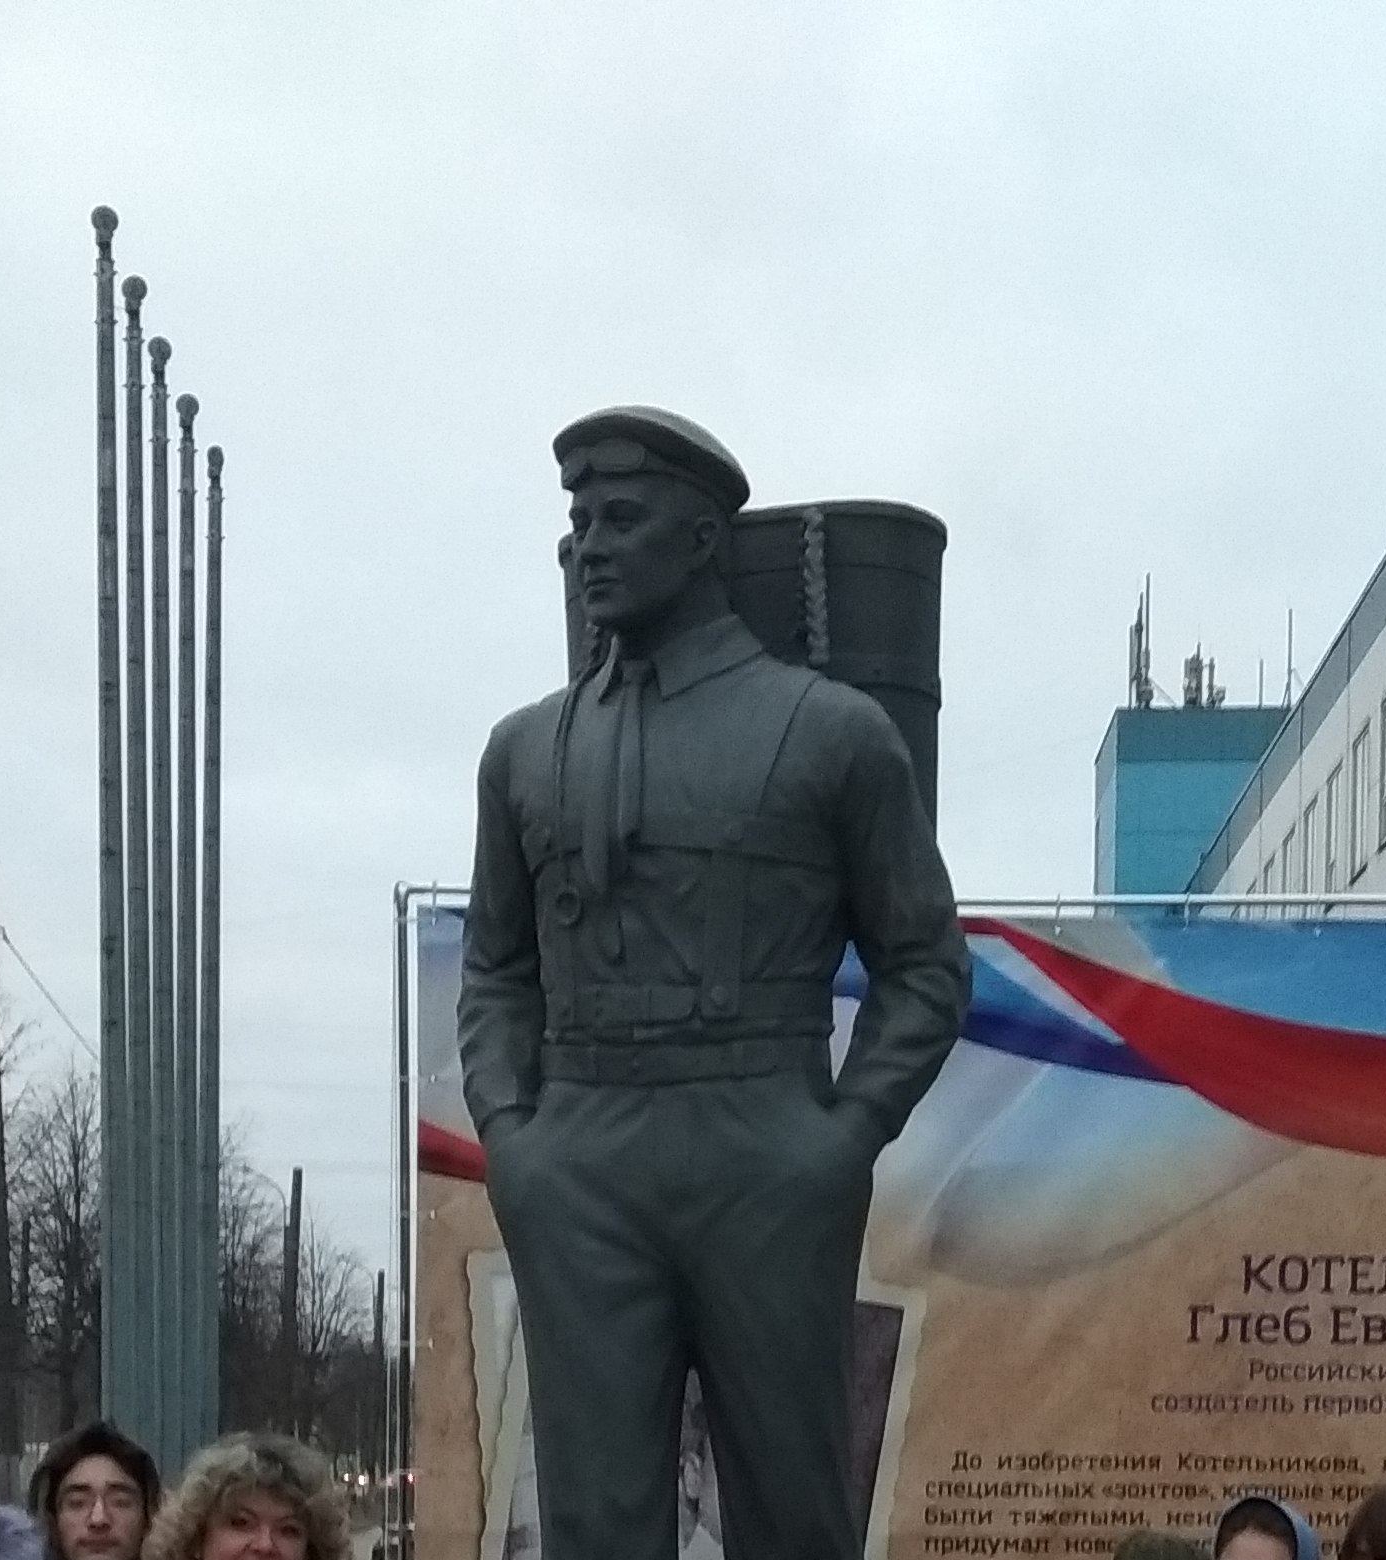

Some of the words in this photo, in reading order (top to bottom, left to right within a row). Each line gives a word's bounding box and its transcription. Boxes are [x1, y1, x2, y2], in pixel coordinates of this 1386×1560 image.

[1187, 1303, 1311, 1345] Глеб
[1151, 1393, 1294, 1416] создатель
[951, 1450, 982, 1473] До
[997, 1451, 1161, 1474] изобретения
[1178, 1452, 1365, 1475] Котельникова,
[925, 1479, 1095, 1501] специальных
[1223, 1483, 1324, 1503] которые
[924, 1505, 993, 1526] были
[924, 1535, 1050, 1556] придумал
